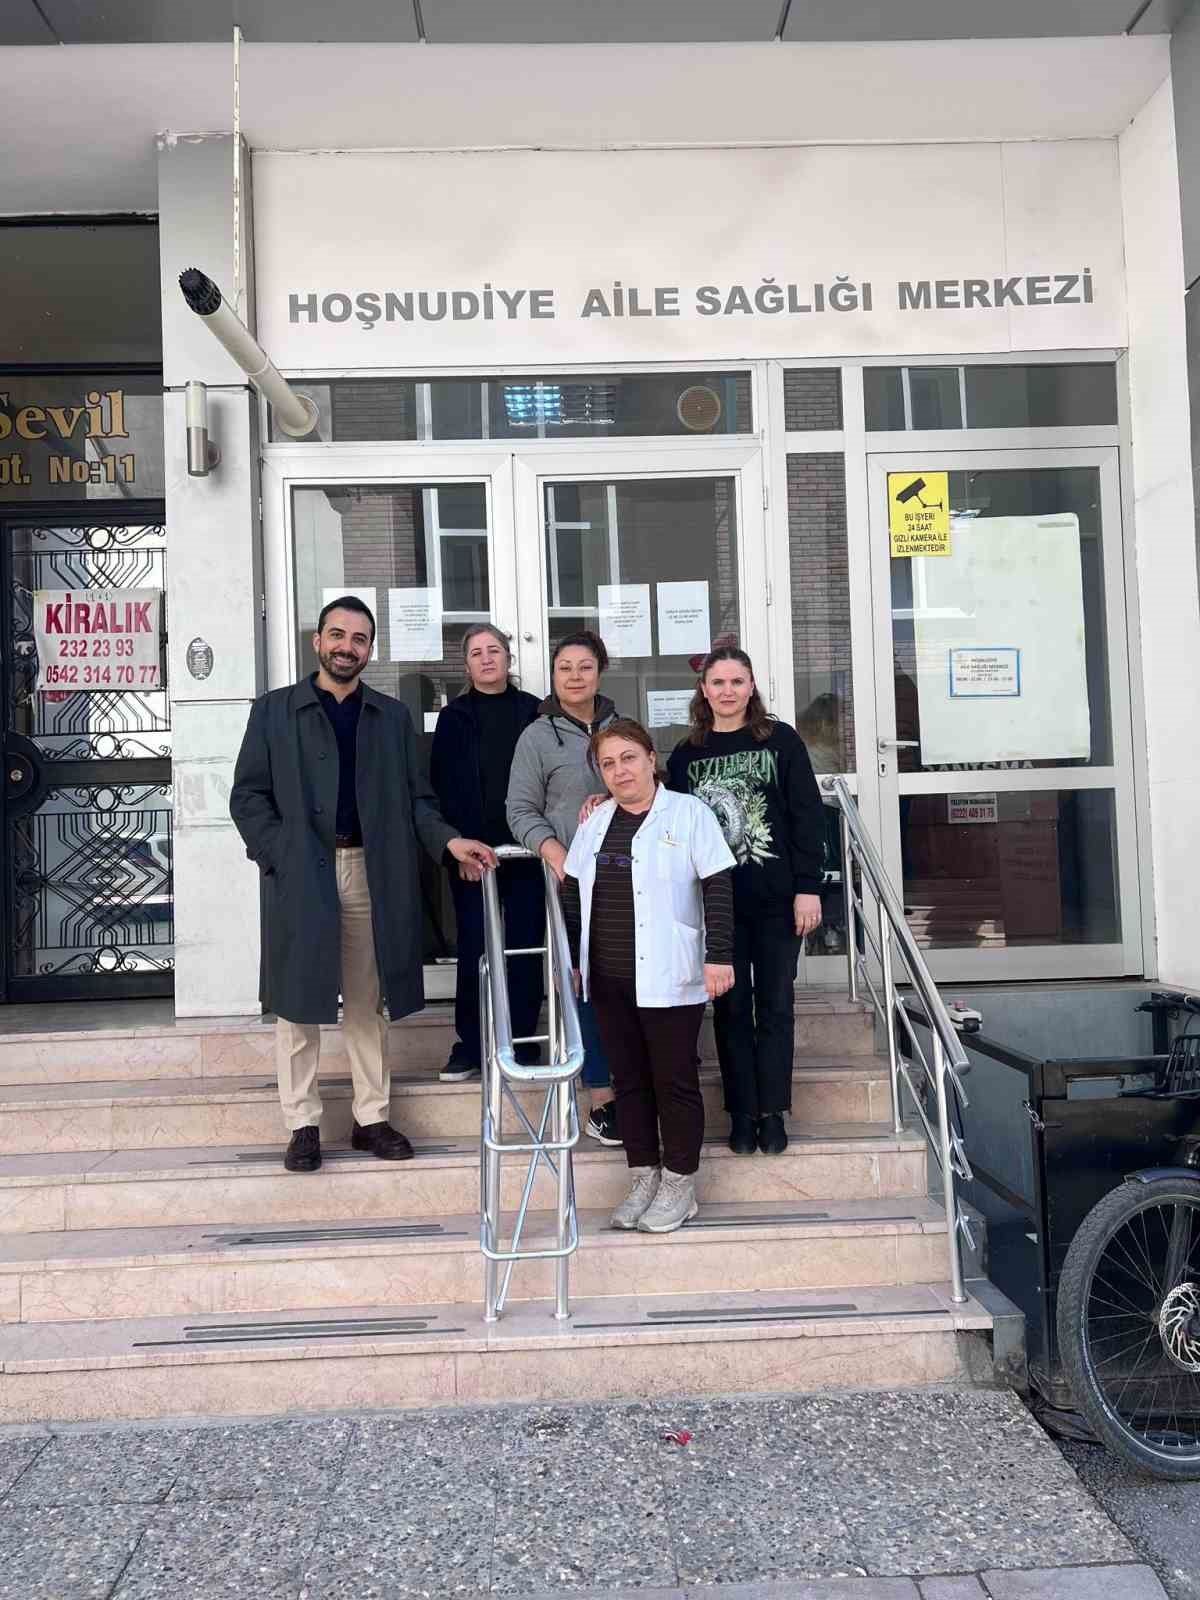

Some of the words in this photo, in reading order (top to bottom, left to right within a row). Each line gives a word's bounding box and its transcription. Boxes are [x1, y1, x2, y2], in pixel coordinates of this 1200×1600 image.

[288, 283, 555, 330] HOŞNUDİYE
[580, 281, 680, 318] AİLE
[695, 275, 873, 315] SAĞLIĞI
[898, 267, 1093, 310] MERKEZİ
[49, 454, 135, 484] No:11
[904, 512, 914, 521] BU
[916, 523, 933, 531] SAAT
[45, 593, 152, 634] KİRALIK
[59, 639, 87, 657] 232
[92, 639, 110, 657] 23
[116, 639, 134, 657] 93
[46, 665, 78, 683] 0542
[83, 665, 111, 683] 314
[116, 665, 135, 683] 70
[139, 665, 157, 684] 77
